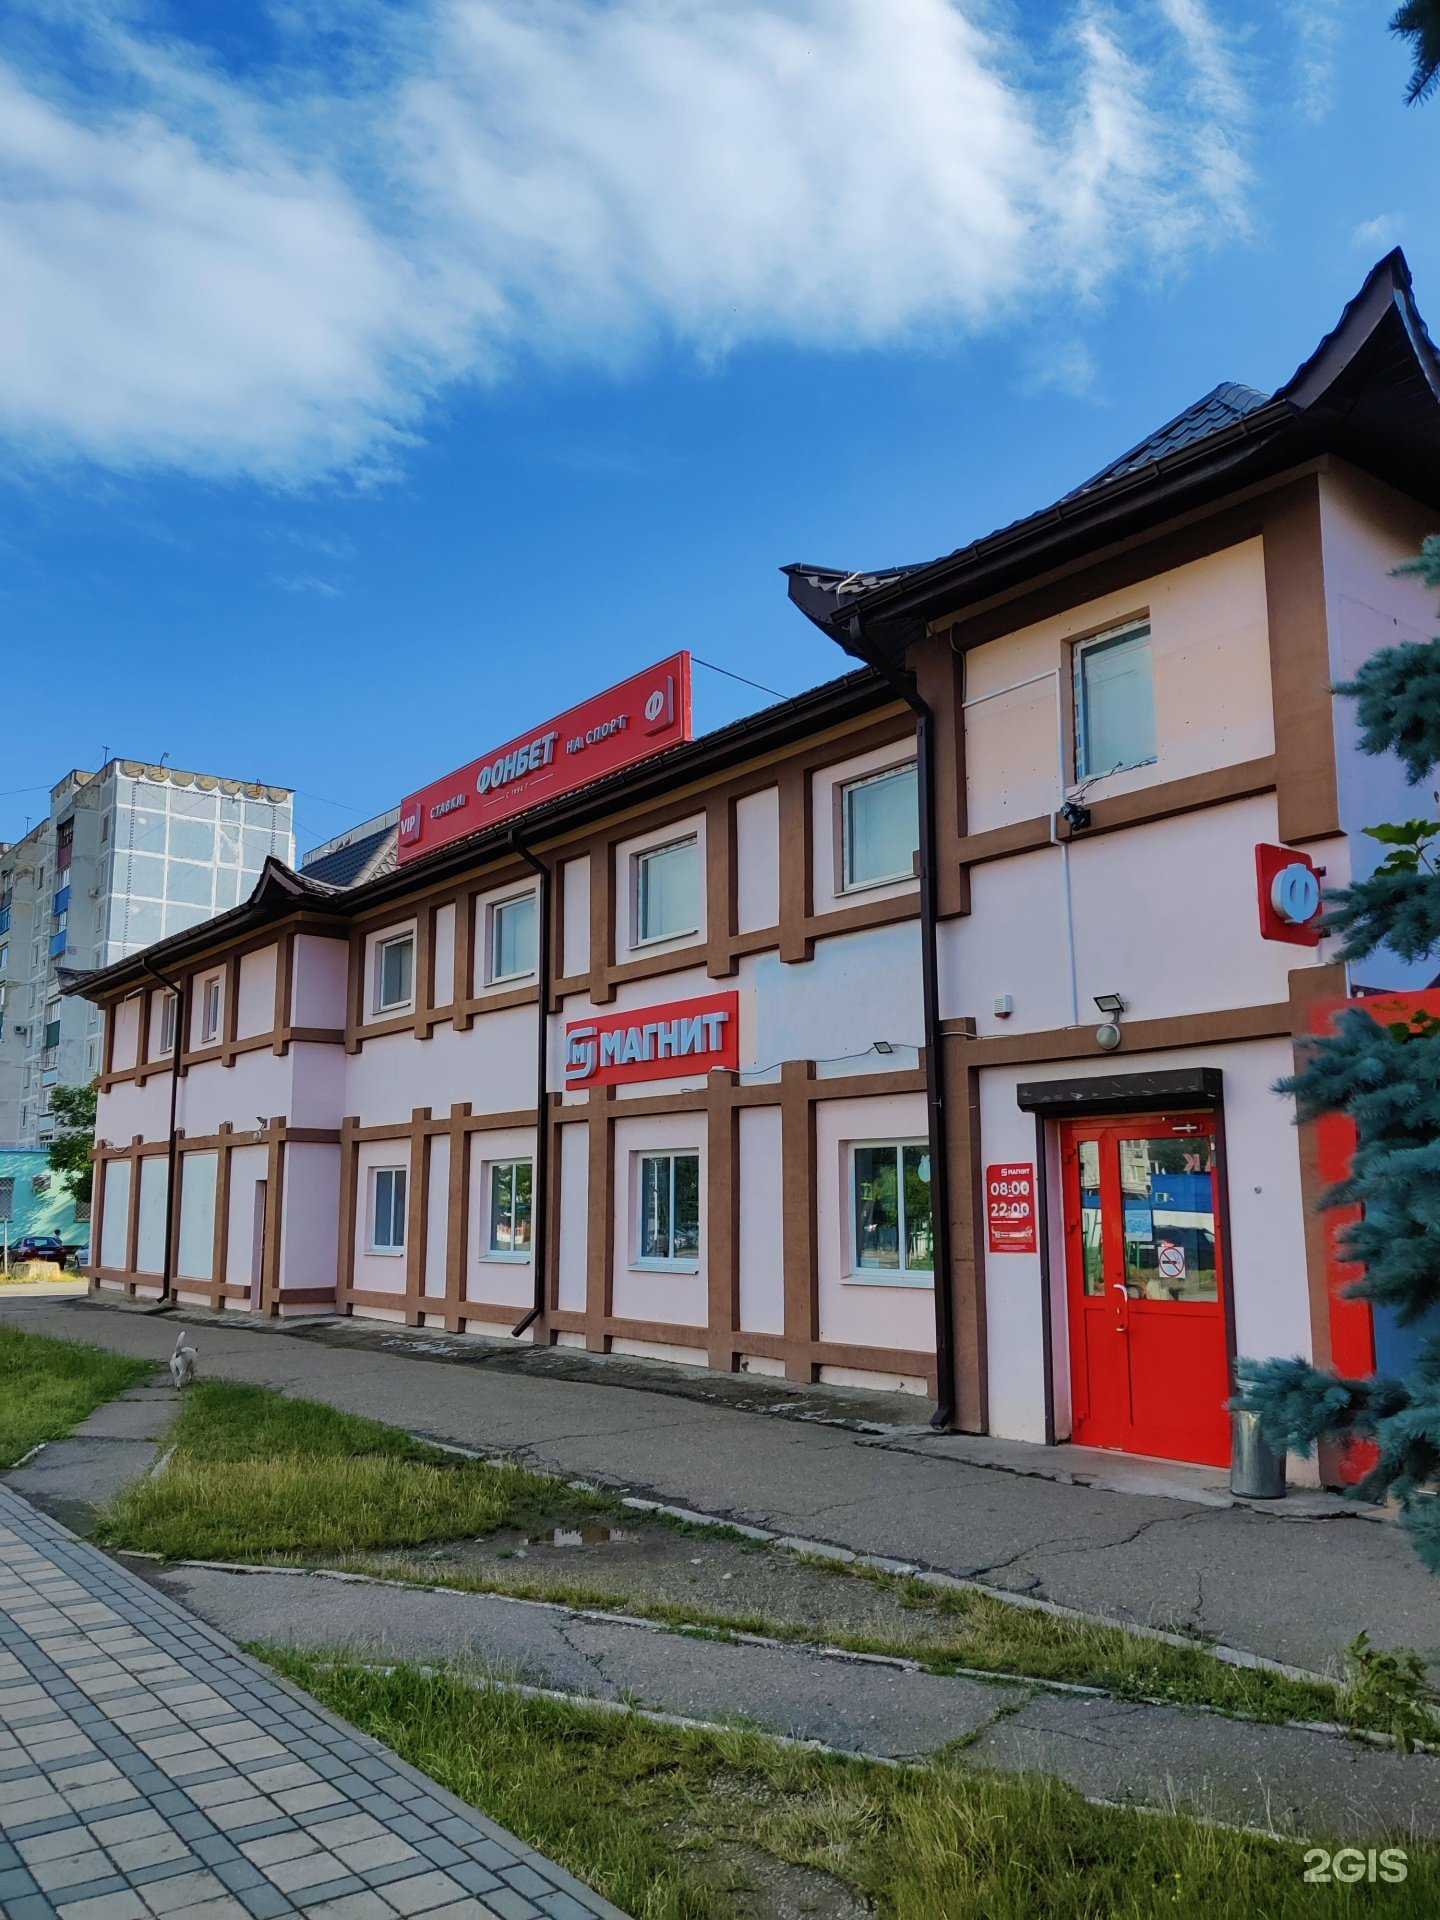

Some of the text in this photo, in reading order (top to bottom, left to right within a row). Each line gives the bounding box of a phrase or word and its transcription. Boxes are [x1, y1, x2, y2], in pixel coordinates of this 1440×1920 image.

[430, 714, 629, 819] СТАВКИ ФОНБЕТ НА СПОРТ
[400, 815, 416, 836] VIP
[600, 1011, 729, 1067] МАГНИТ
[990, 1180, 1030, 1196] 08:00
[990, 1202, 1030, 1218] 22:00
